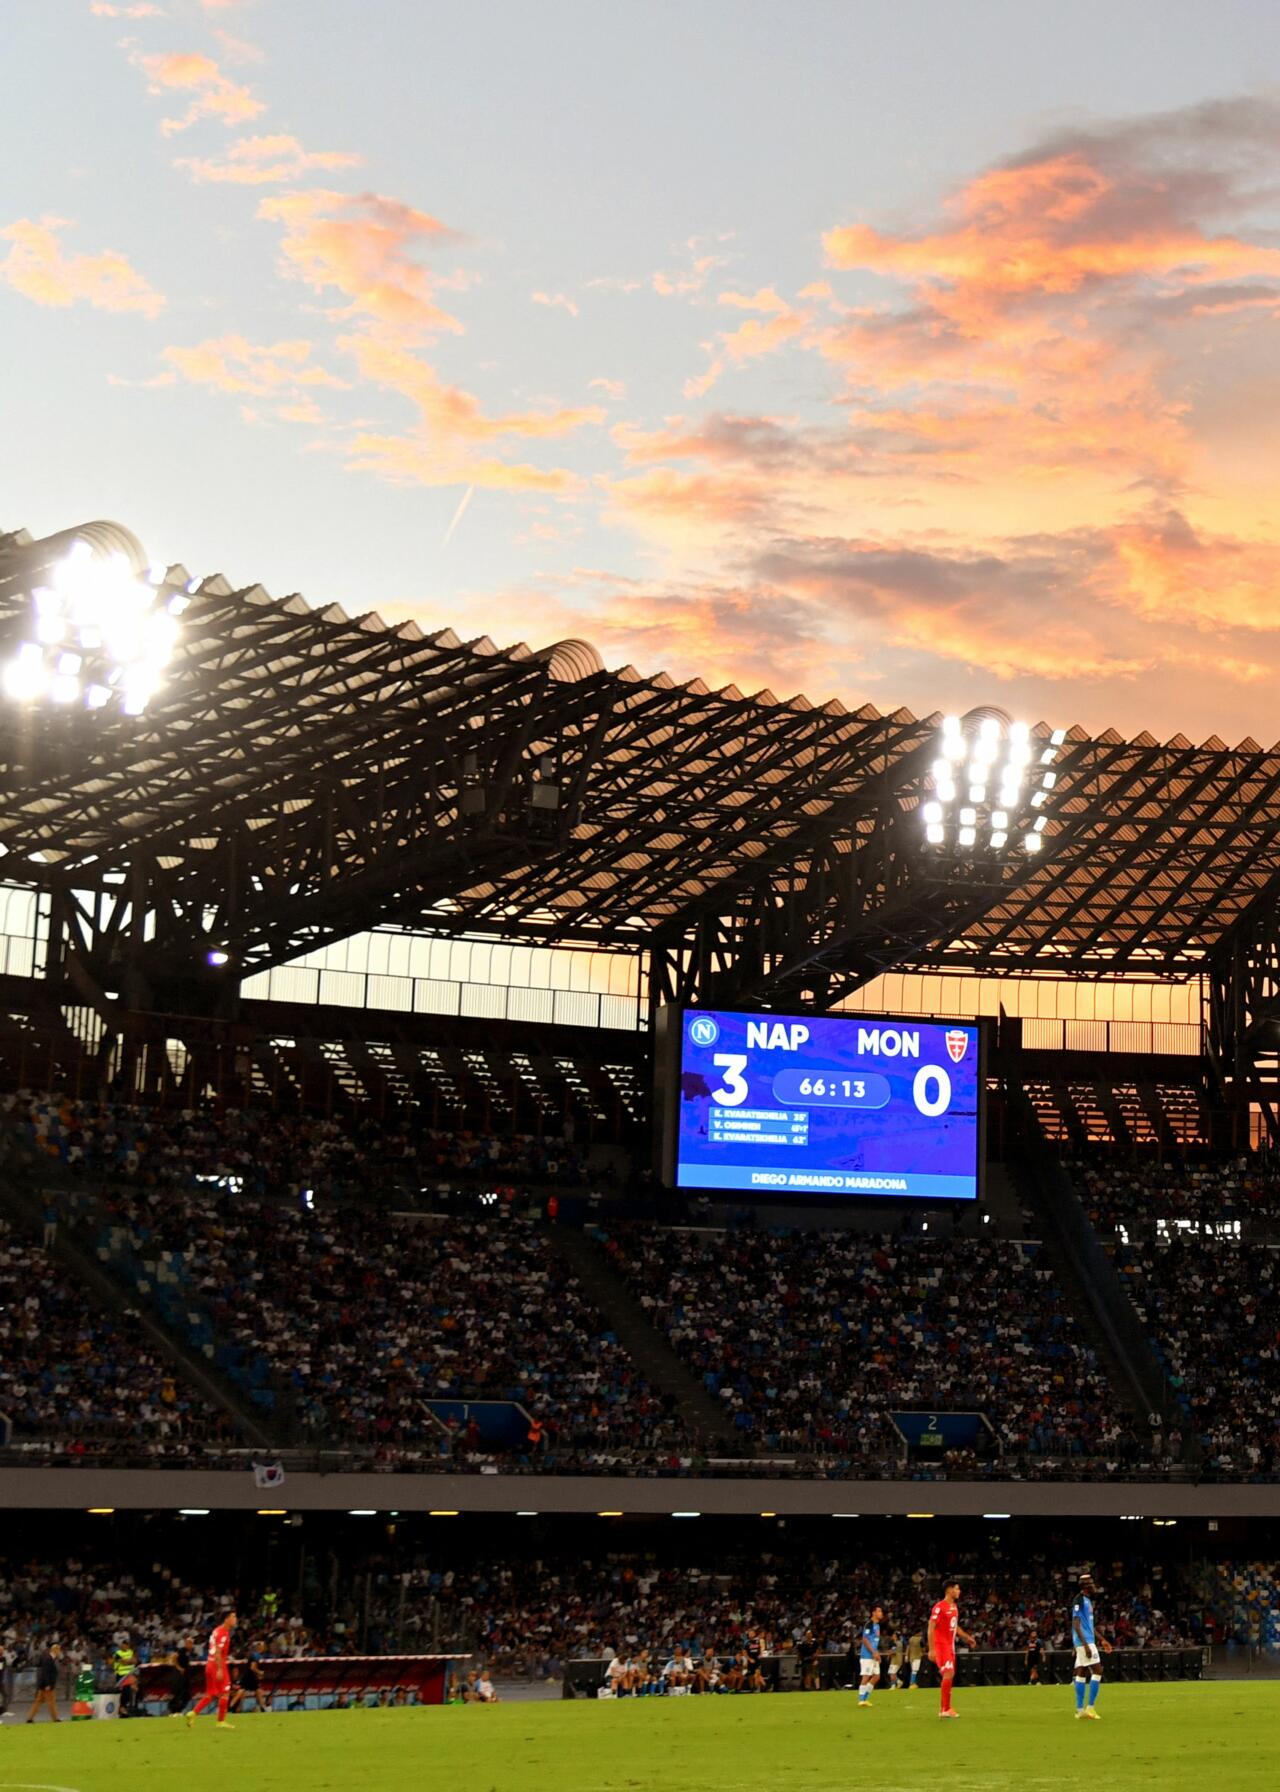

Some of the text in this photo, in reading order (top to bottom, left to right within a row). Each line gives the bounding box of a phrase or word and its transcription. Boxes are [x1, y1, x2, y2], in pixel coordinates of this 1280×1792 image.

[746, 1021, 810, 1051] NAP
[857, 1028, 920, 1057] MON
[711, 1053, 749, 1107] 3
[912, 1064, 952, 1117] 0
[751, 1172, 908, 1190] DIEGO ARMANDO MARADONA
[927, 1415, 938, 1431] 2
